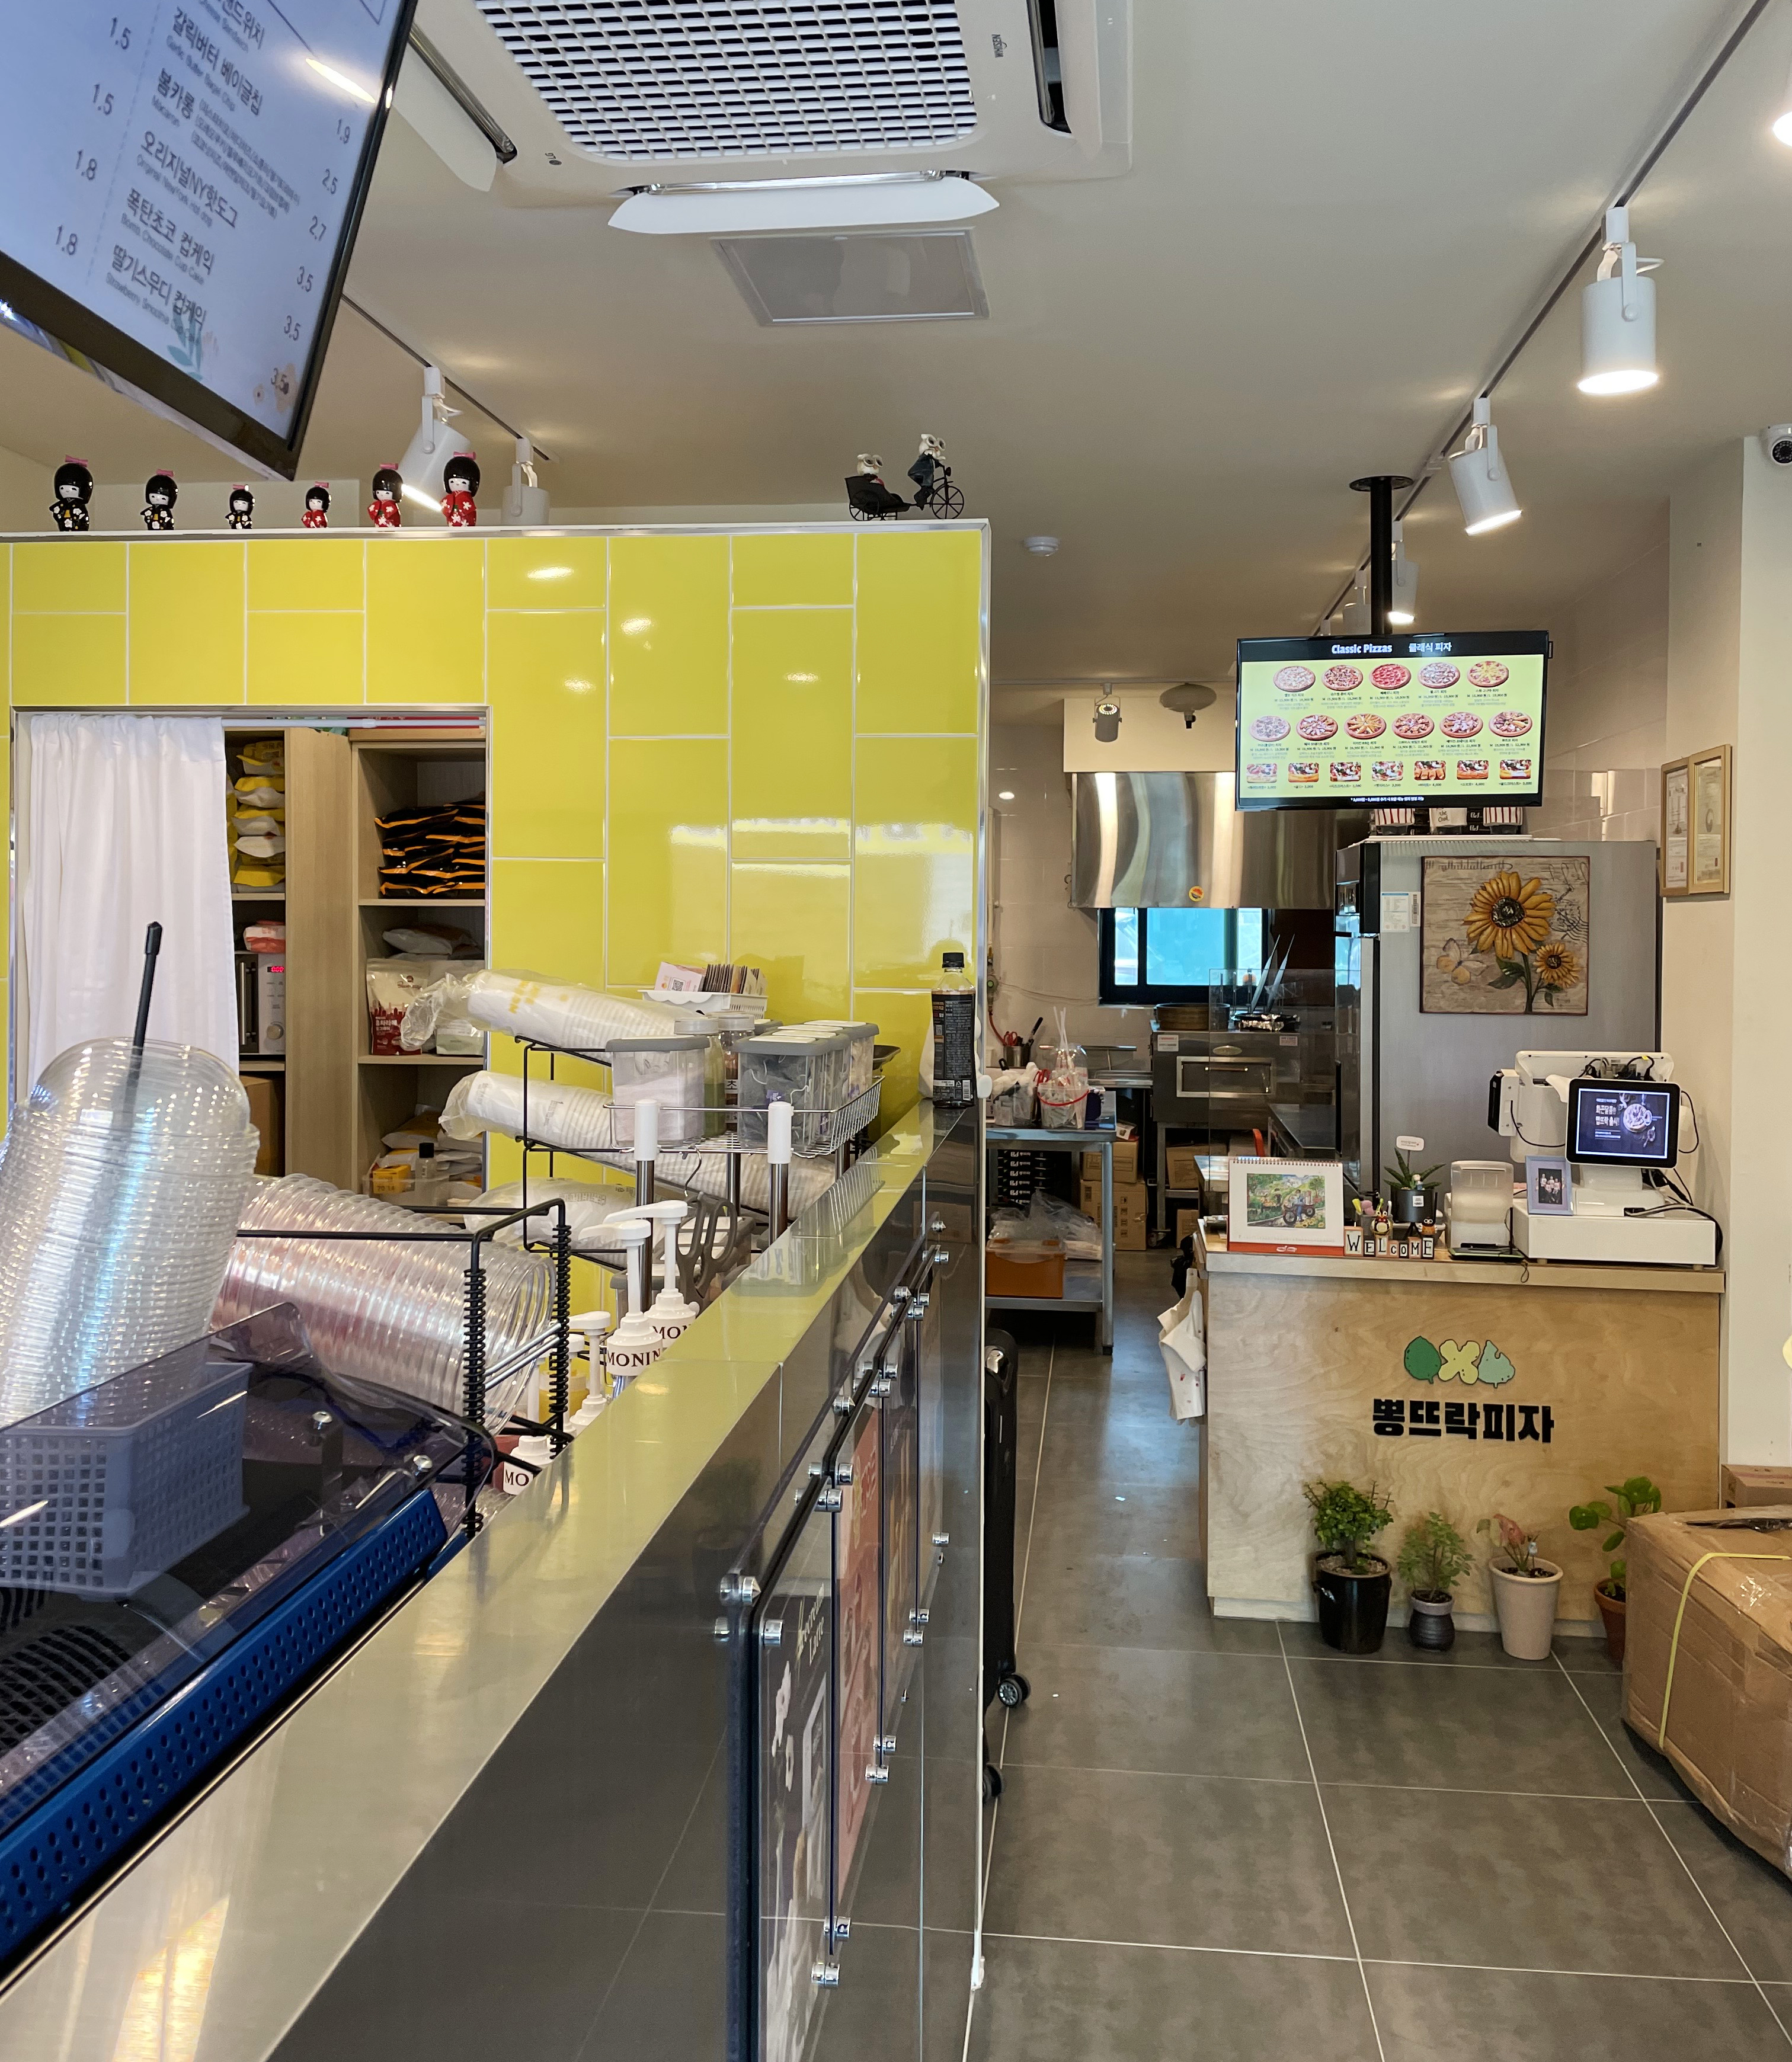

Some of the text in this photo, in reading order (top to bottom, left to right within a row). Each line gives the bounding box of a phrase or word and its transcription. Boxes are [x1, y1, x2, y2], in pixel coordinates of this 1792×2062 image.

[110, 17, 131, 50] 1.5
[173, 6, 220, 71] 갈릭버터
[221, 57, 263, 116] 베이글칩
[92, 84, 114, 115] 1.5
[157, 68, 194, 120] 봄카롱
[336, 119, 351, 145] 1.9
[75, 149, 98, 181] 1.8
[141, 131, 238, 228] 오리지널NY핫도그
[322, 168, 338, 195] 2.5
[56, 225, 78, 255] 1.8
[127, 187, 215, 276] 폭탄초코 컵케익
[309, 215, 327, 241] 2.7
[112, 245, 172, 306] 딸기스무디
[172, 290, 206, 332] 컵케익
[297, 266, 313, 293] 3.5
[284, 315, 301, 341] 3.5
[270, 367, 288, 392] 3.5
[1331, 643, 1393, 654] Classic Pizzas
[1409, 641, 1452, 653] 클래식 피자
[607, 1348, 661, 1367] MONIN
[1372, 1398, 1554, 1443] 뽕뜨락피자
